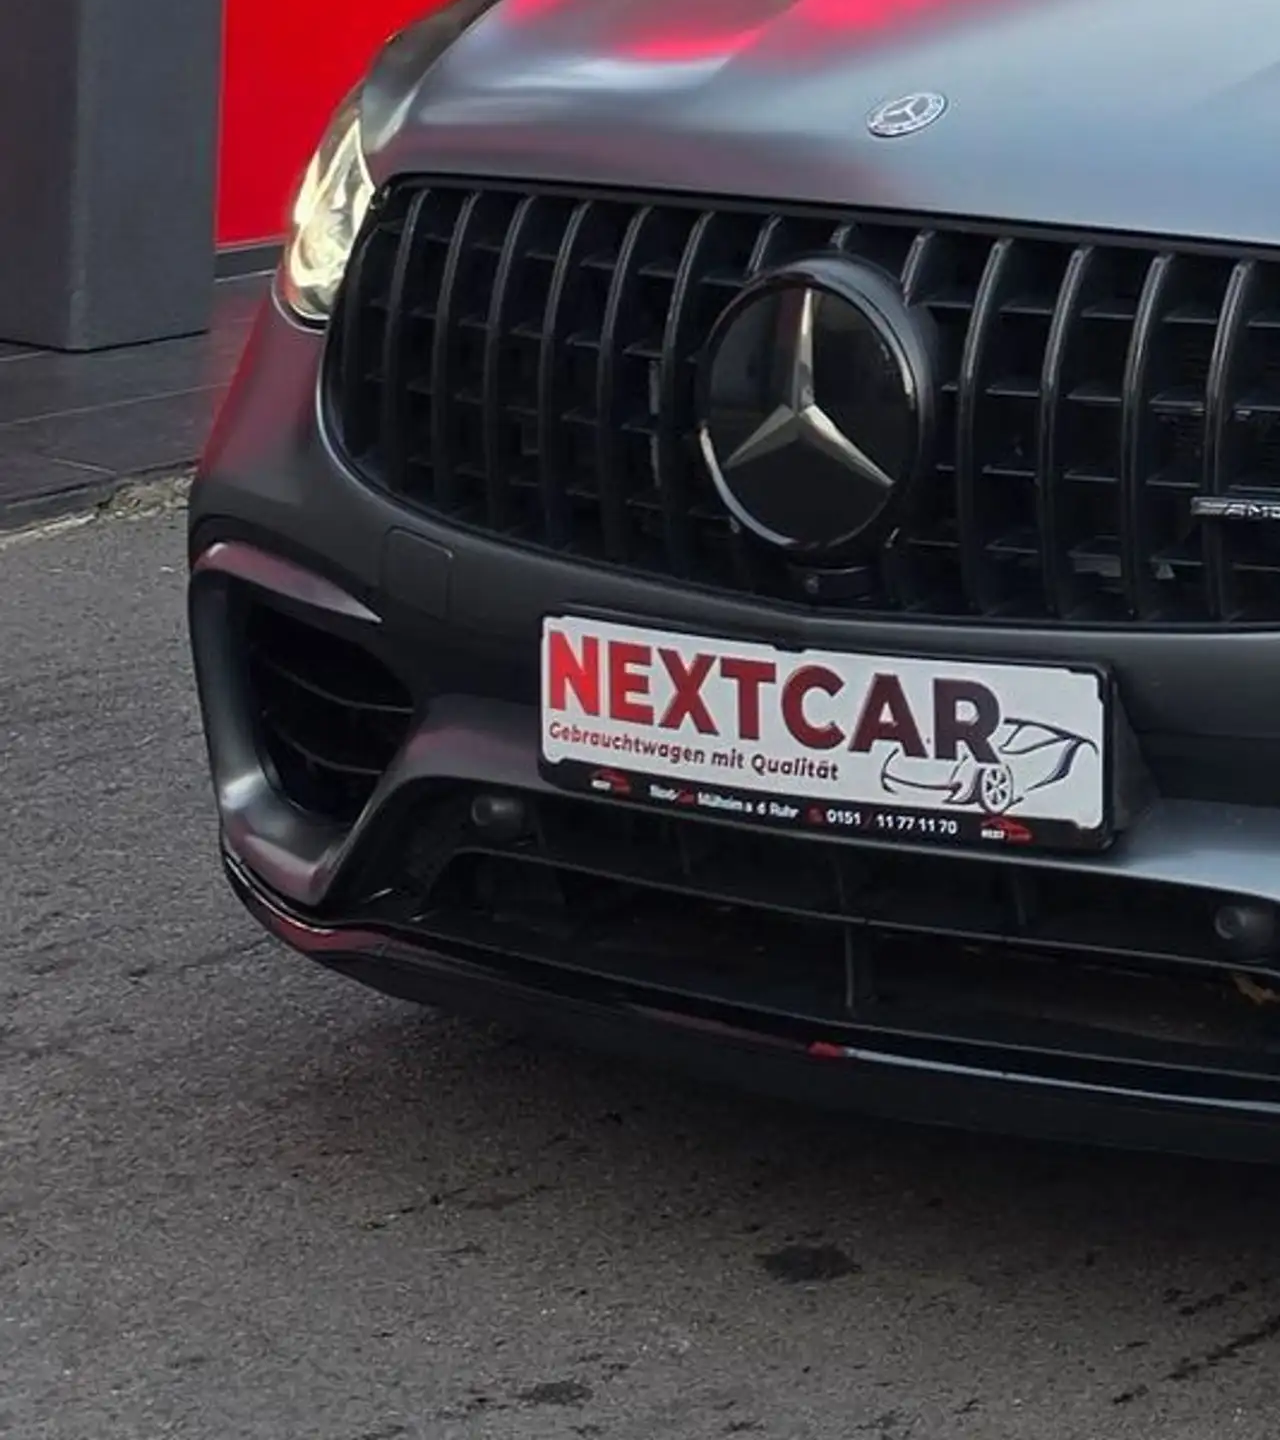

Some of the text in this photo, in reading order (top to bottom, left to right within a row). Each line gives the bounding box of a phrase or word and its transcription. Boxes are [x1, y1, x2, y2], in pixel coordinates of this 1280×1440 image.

[548, 630, 1002, 765] NEXTCAR
[548, 722, 838, 780] Gebrauchtwagen mit Qualität
[825, 809, 861, 826] 0151
